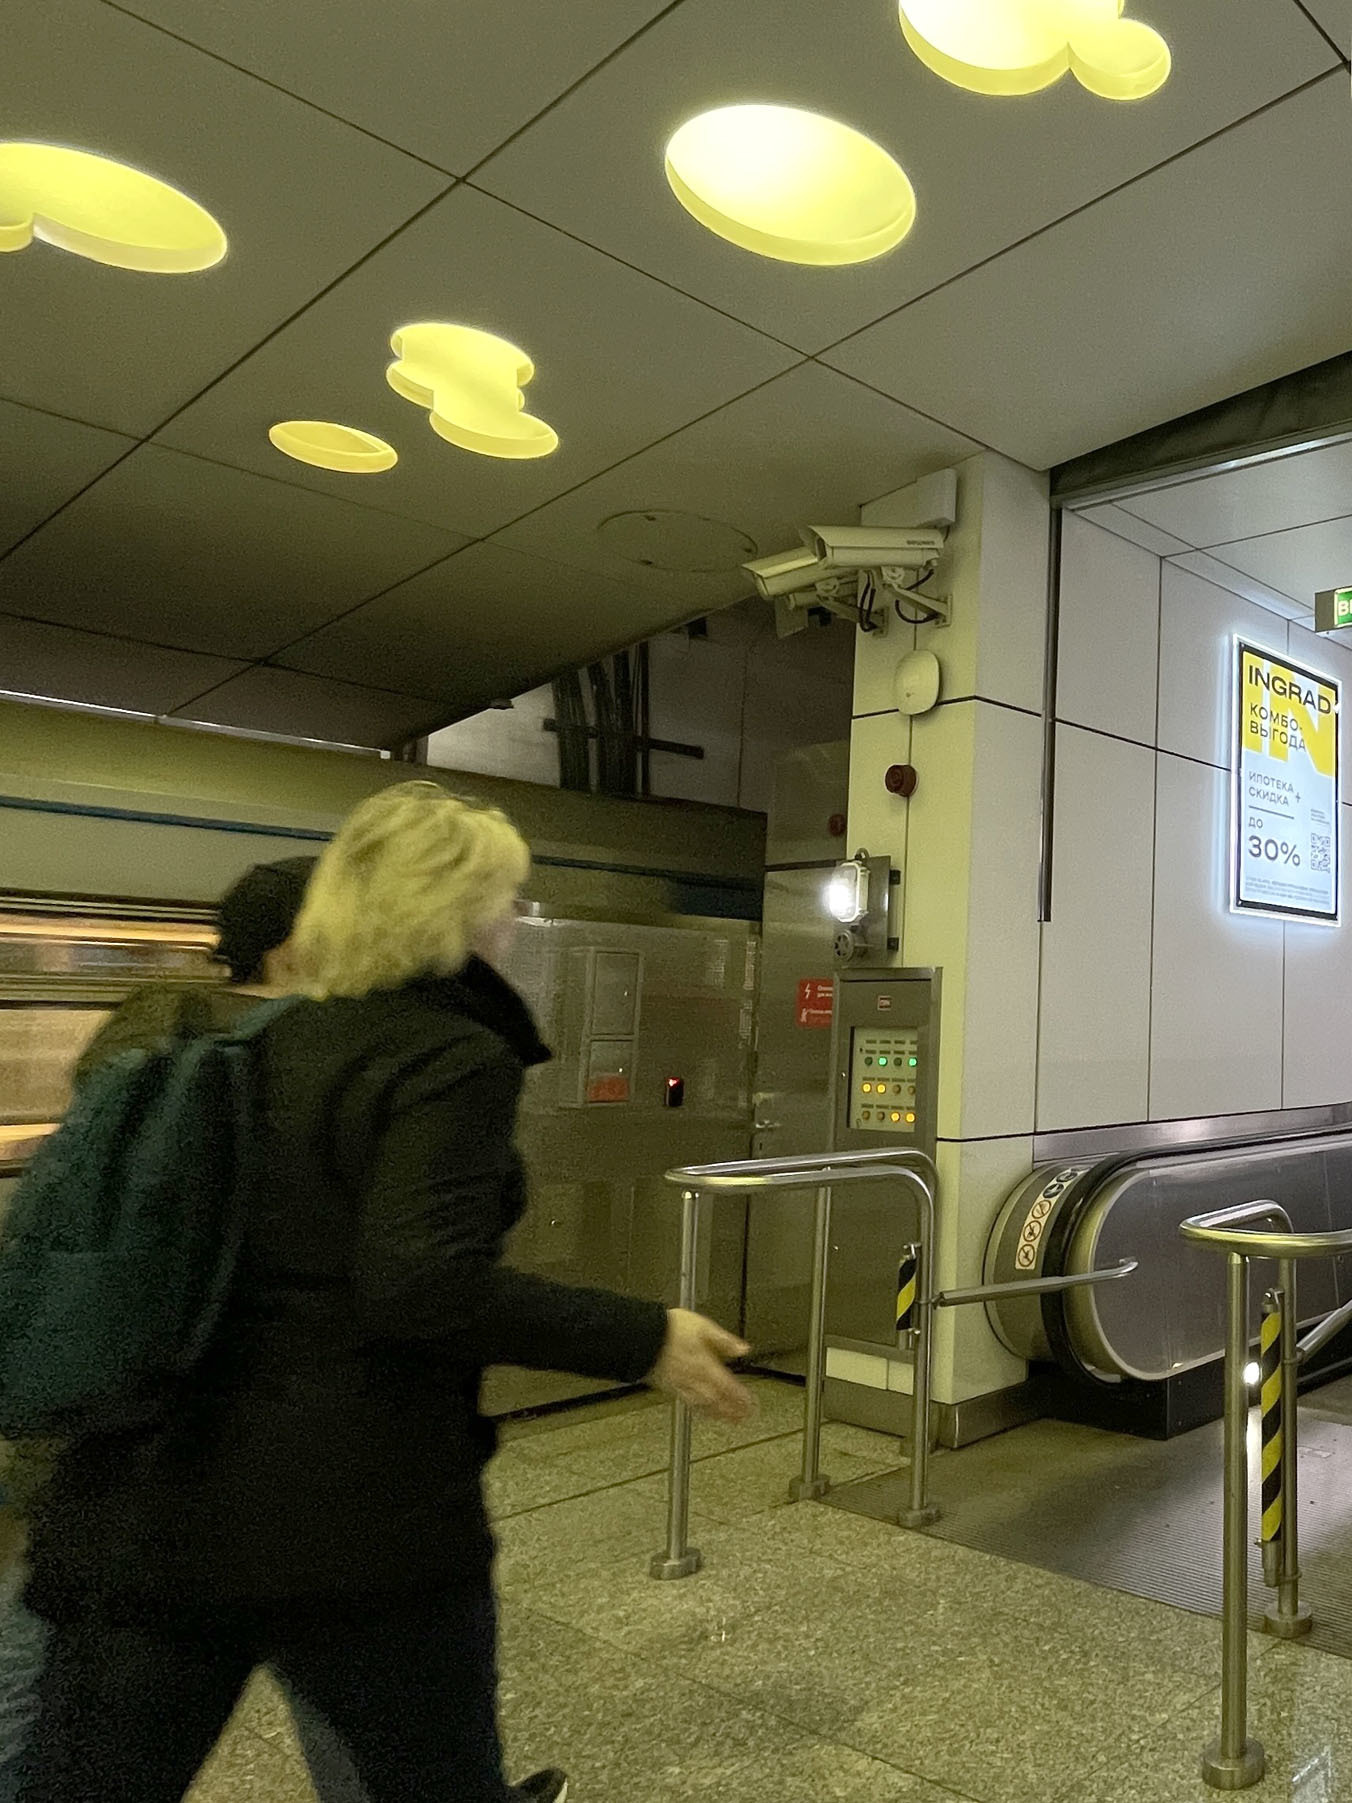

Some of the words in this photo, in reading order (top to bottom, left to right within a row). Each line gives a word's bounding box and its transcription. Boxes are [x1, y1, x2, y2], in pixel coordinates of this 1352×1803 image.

[1249, 665, 1331, 714] INGRAD
[1250, 720, 1306, 751] ВЫГОДА
[1248, 787, 1290, 806] СКИДКА
[1249, 771, 1294, 793] ИПОТЕКА
[1248, 835, 1301, 866] 30%
